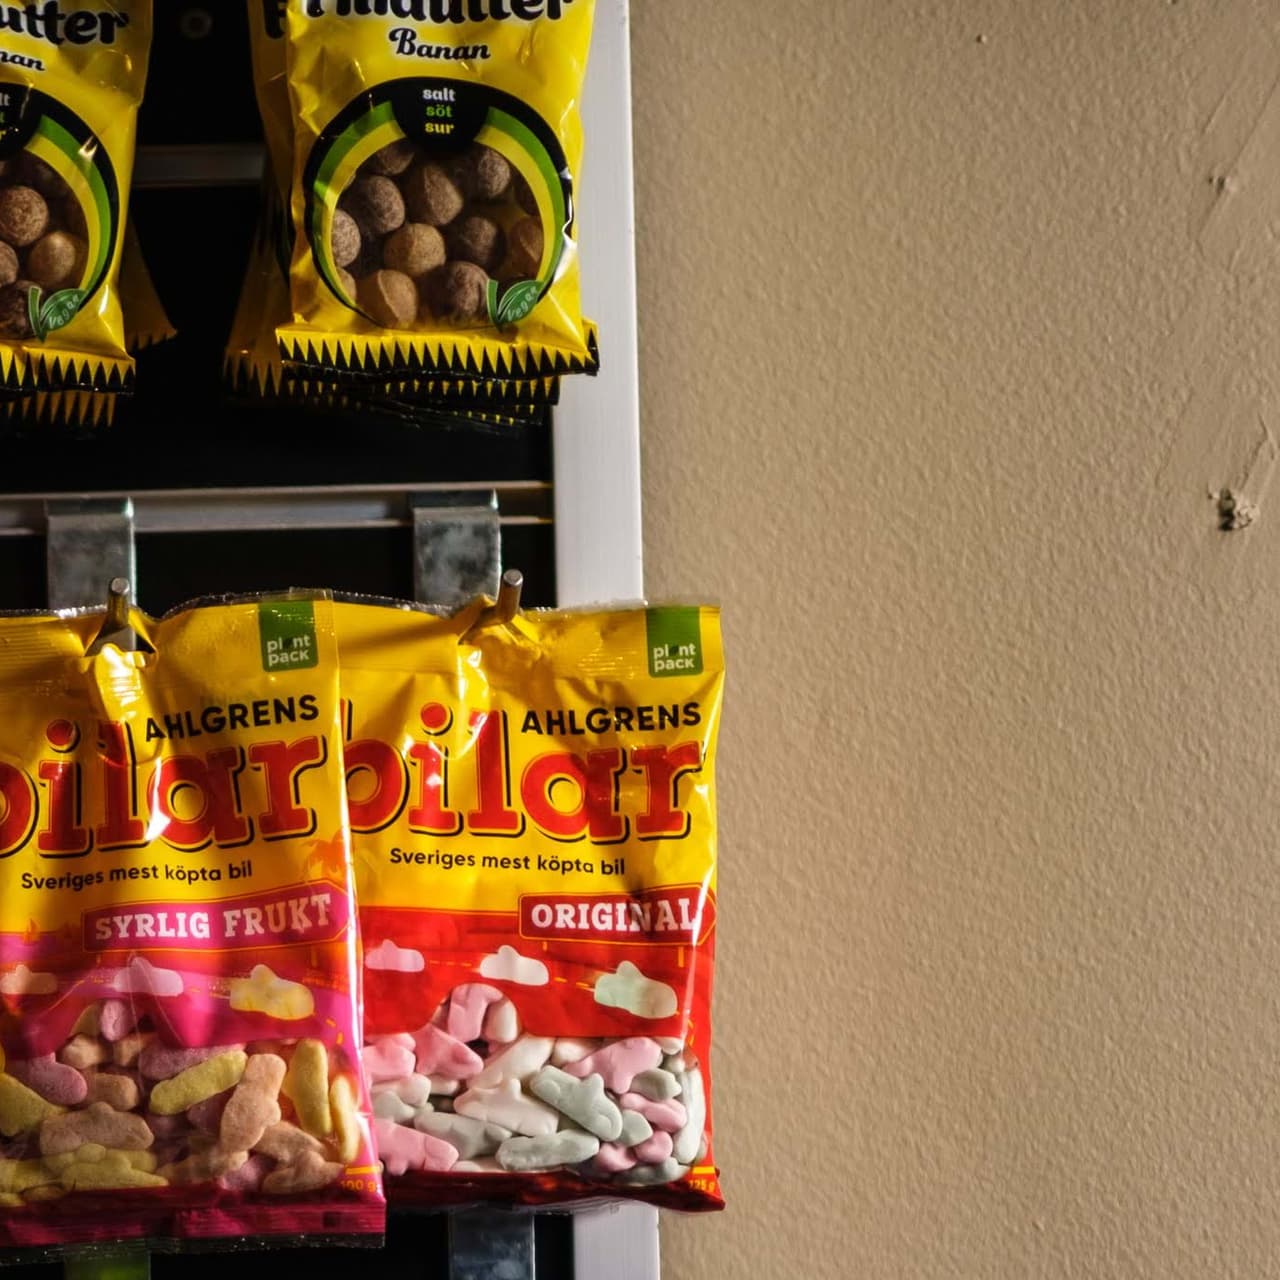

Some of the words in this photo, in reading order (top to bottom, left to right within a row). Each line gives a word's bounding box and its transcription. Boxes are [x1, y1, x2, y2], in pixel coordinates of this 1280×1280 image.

[389, 28, 491, 60] Banan
[422, 88, 456, 102] salt
[426, 104, 453, 118] söt
[425, 122, 455, 134] sur
[268, 649, 310, 666] pack
[654, 657, 695, 672] pack
[145, 695, 320, 743] AHLGRENS
[521, 702, 702, 736] AHLGRENS
[341, 698, 705, 845] bilar
[21, 872, 104, 891] Sveriges
[110, 866, 159, 882] mest
[165, 863, 222, 883] köpta
[229, 861, 252, 879] bil
[390, 847, 476, 869] Sveriges
[482, 855, 530, 872] mest
[537, 855, 594, 876] köpta
[600, 859, 626, 876] bil
[96, 911, 210, 940] SYRLIG
[223, 894, 331, 937] FRUKT
[531, 898, 696, 932] ORIGINAL
